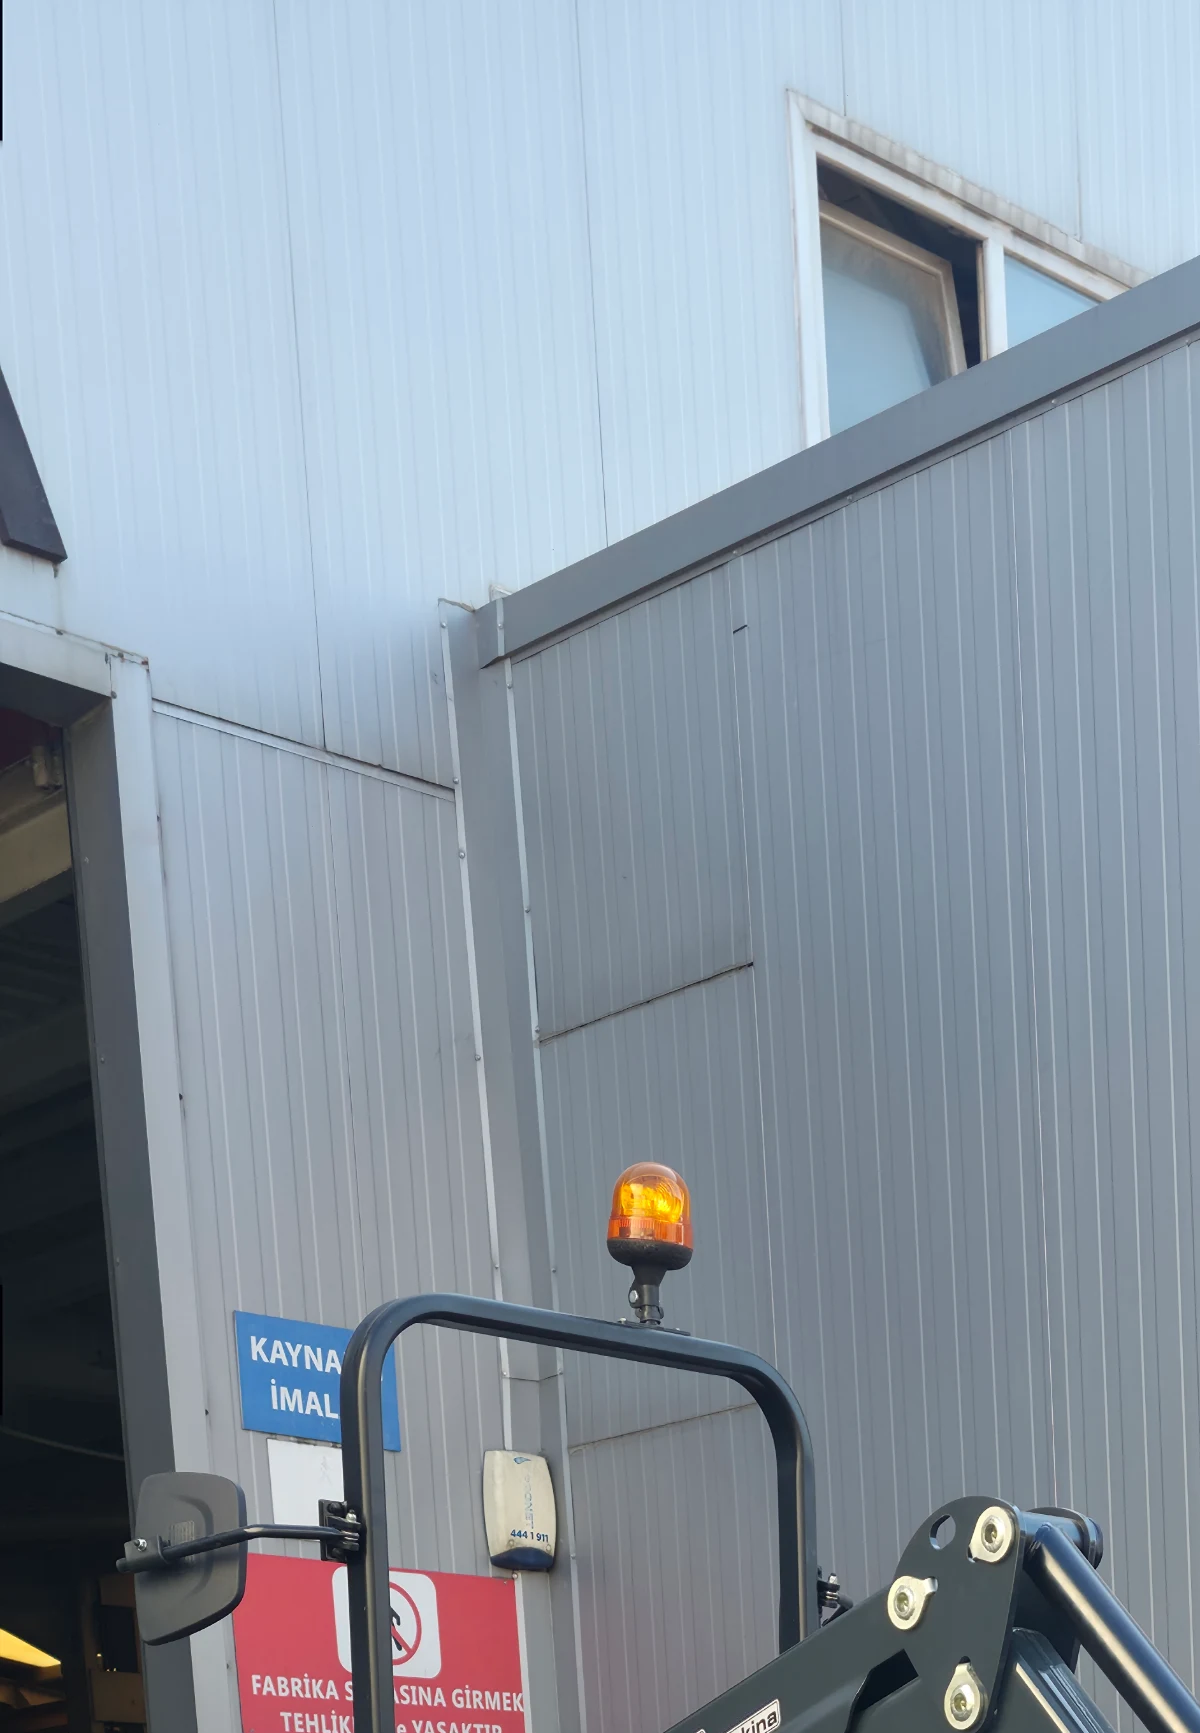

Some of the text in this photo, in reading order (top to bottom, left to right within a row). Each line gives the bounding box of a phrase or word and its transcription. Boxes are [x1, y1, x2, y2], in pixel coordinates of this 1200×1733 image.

[250, 1336, 346, 1375] KAYNA
[270, 1378, 339, 1419] İMAL
[510, 1529, 528, 1539] 444
[536, 1532, 549, 1543] 911
[251, 1673, 340, 1701] FABRİKA
[452, 1684, 524, 1713] GİRMEK
